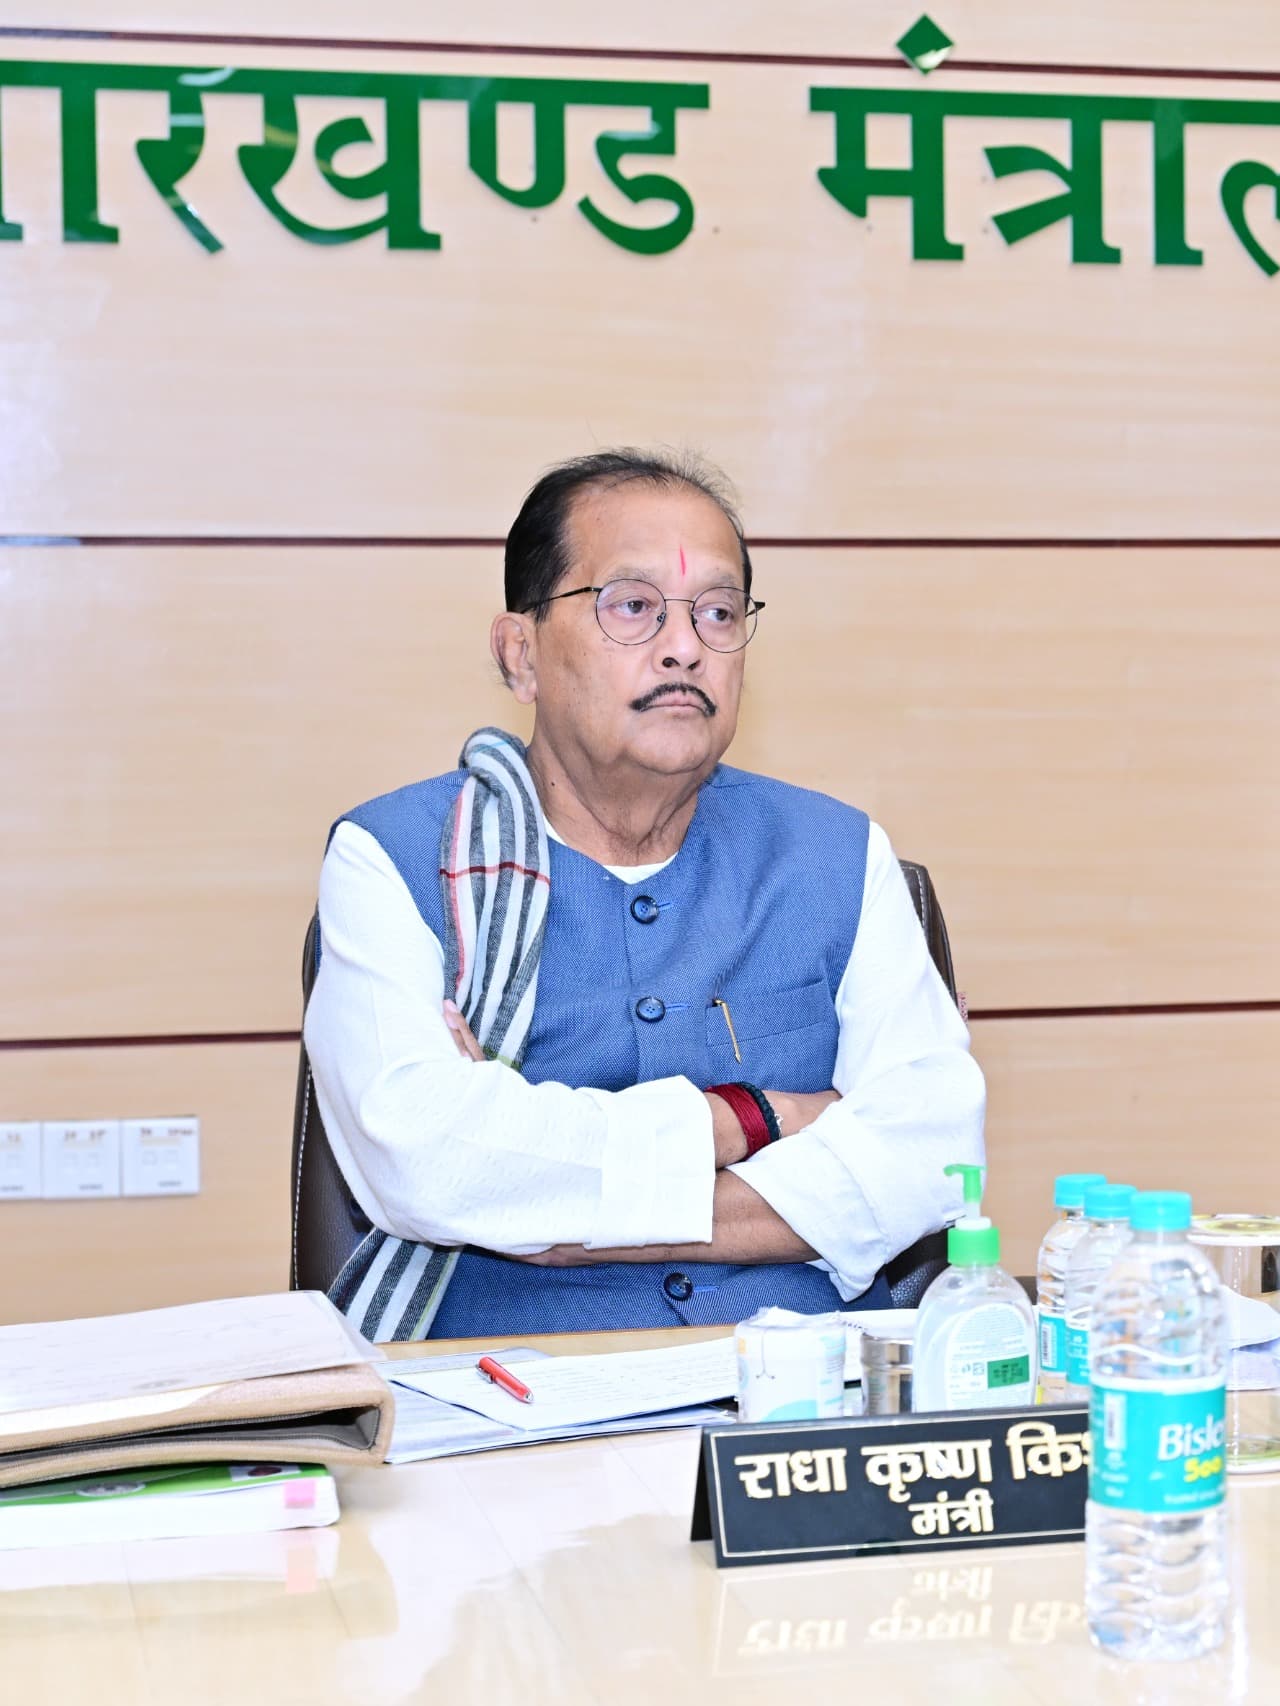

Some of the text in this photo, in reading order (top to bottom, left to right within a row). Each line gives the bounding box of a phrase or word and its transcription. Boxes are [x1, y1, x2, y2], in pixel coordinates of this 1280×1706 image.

[734, 1420, 1092, 1503] राधा कृष्ण कि
[908, 1488, 994, 1536] मंत्री
